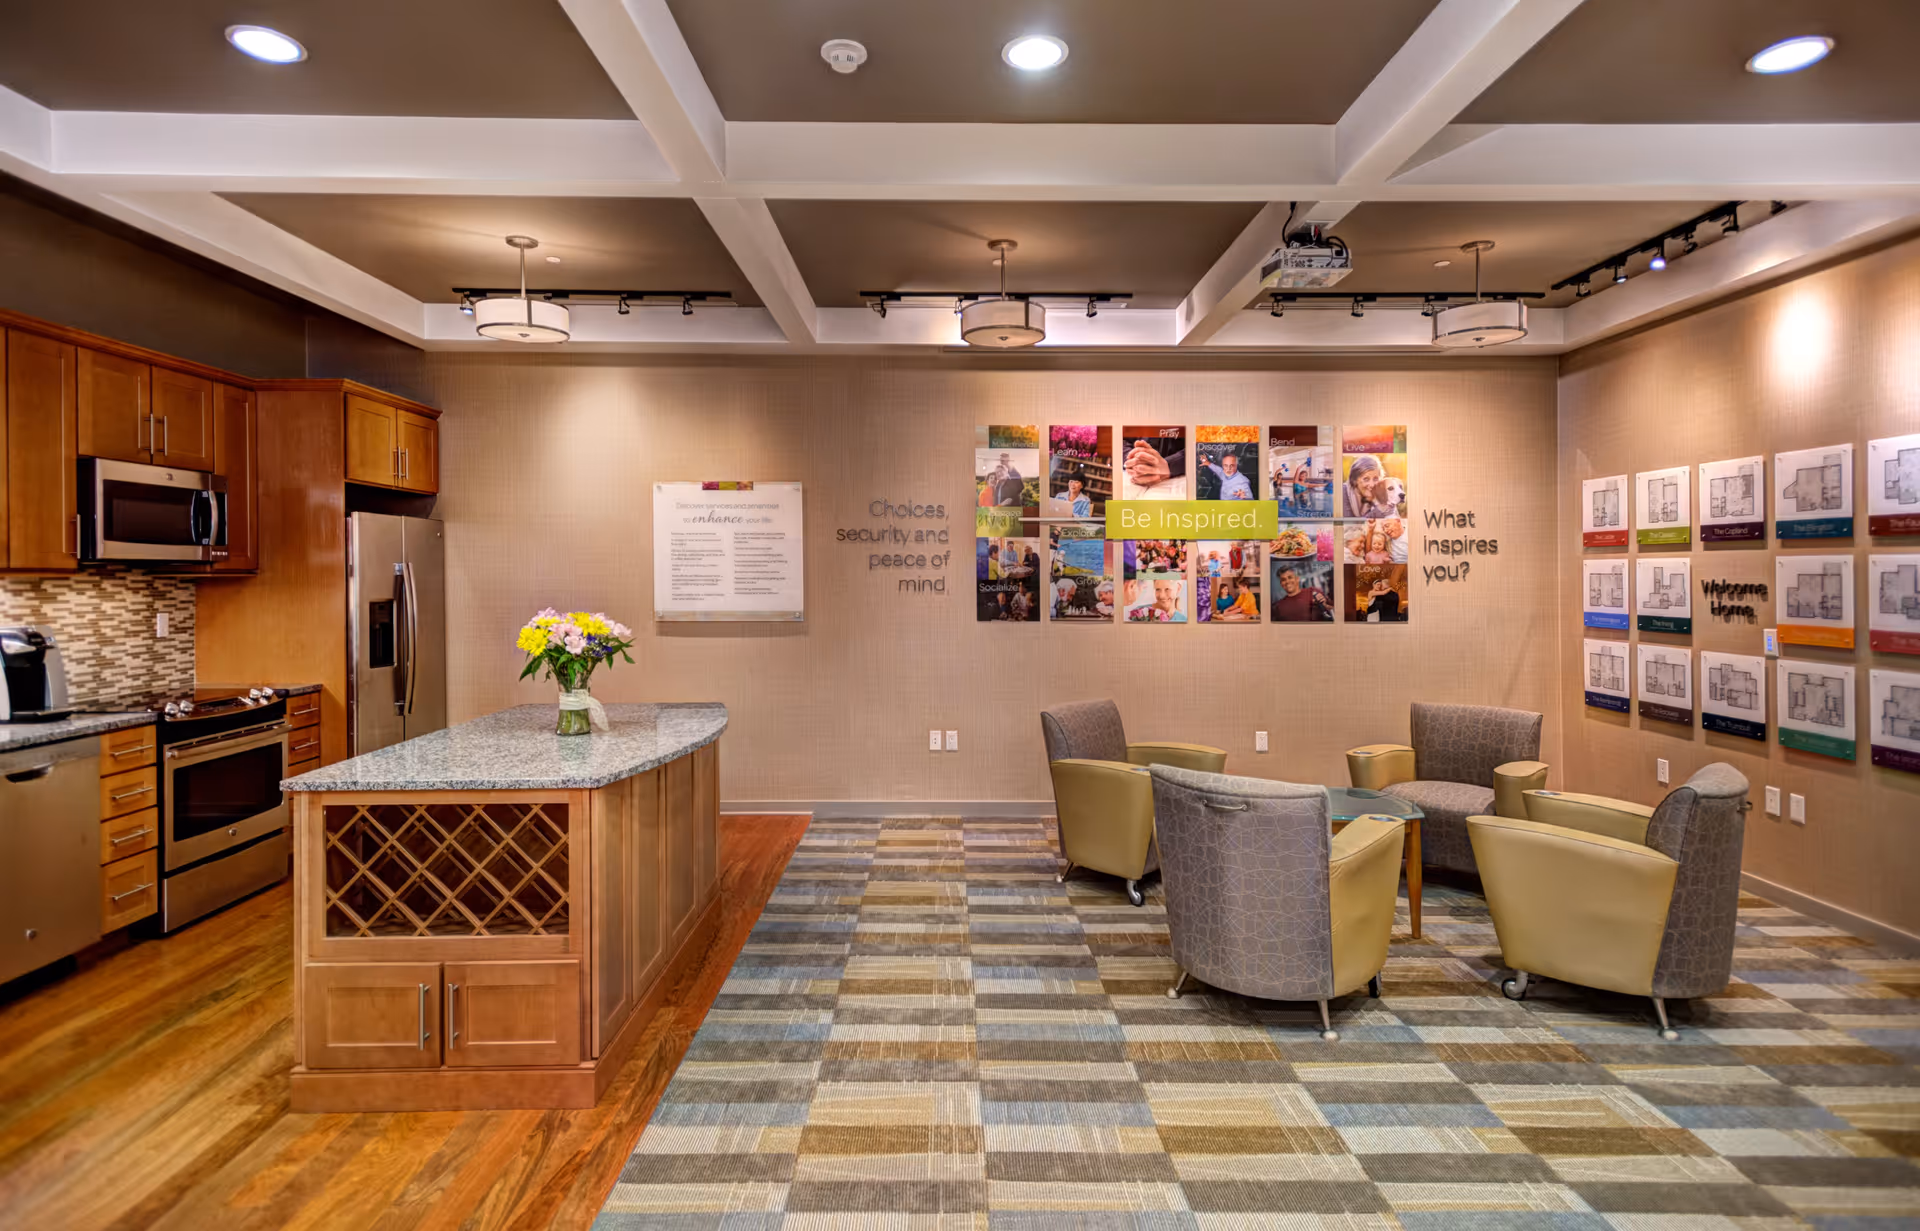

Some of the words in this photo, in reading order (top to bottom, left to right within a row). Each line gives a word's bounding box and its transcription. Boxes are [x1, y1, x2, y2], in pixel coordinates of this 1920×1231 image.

[1159, 429, 1180, 439] Pray
[1197, 443, 1237, 451] Discover
[1270, 438, 1295, 446] Bend
[1346, 443, 1366, 452] Live
[1052, 448, 1078, 456] Learn
[869, 499, 949, 520] Choices,
[692, 510, 743, 523] enhance
[1122, 509, 1151, 528] Be
[1160, 508, 1263, 532] Inspired.
[1424, 509, 1475, 528] What
[836, 525, 911, 547] security
[914, 526, 949, 543] and
[1061, 529, 1095, 538] Explore
[1423, 535, 1498, 559] inspires
[869, 554, 927, 569] peace
[931, 550, 950, 566] of
[1423, 561, 1470, 587] you?
[979, 583, 1019, 592] Socialize
[1076, 577, 1101, 585] Grow
[1701, 579, 1768, 594] Welcome
